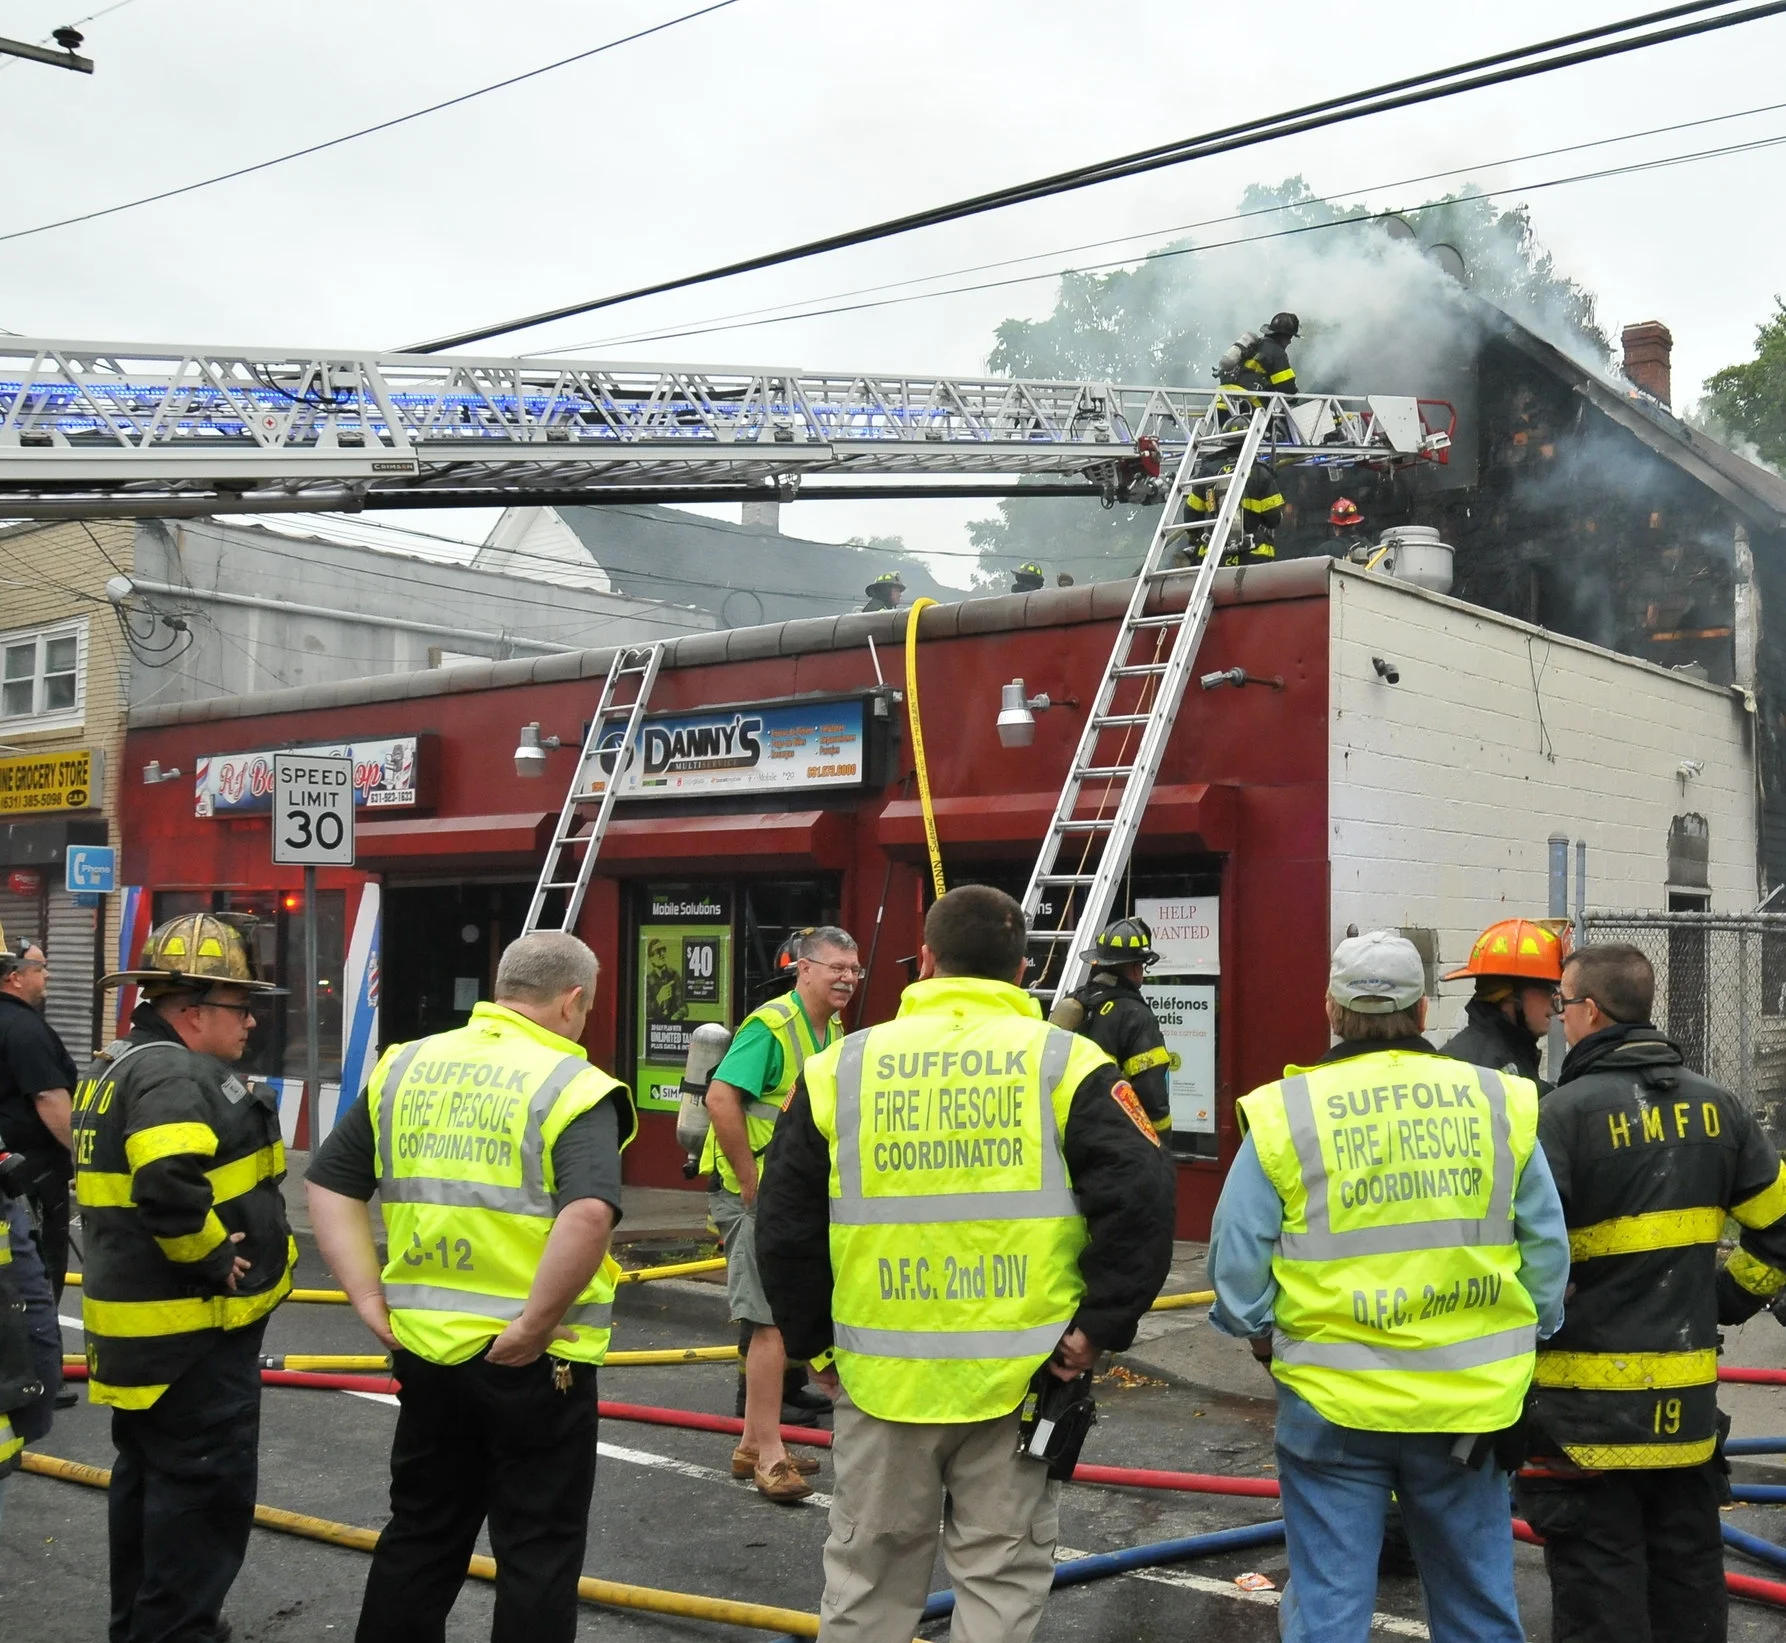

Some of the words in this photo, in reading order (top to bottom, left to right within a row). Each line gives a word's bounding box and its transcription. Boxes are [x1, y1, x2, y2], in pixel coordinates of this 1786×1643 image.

[1225, 555, 1240, 566] 24
[643, 714, 762, 774] DANNY'S
[15, 763, 56, 792] GROCERY
[58, 760, 88, 788] STORE
[218, 762, 248, 797] RJ
[281, 767, 347, 786] SPEED
[289, 790, 339, 807] LIMIT
[284, 810, 344, 850] 30
[82, 864, 111, 874] Phone
[652, 902, 679, 915] Mobile
[680, 902, 721, 915] Solutions
[1159, 905, 1197, 920] HELP
[1151, 925, 1210, 940] WANTED
[687, 945, 713, 977] $40
[1145, 996, 1208, 1011] Teléfonos
[409, 1061, 532, 1093] SUFFOLK
[877, 1050, 1028, 1080] SUFFOLK
[400, 1090, 434, 1127] FIRE
[447, 1091, 519, 1135] RESCUE
[874, 1090, 920, 1132] FIRE
[939, 1086, 1025, 1130] RESCUE
[1327, 1083, 1476, 1119] SUFFOLK
[399, 1132, 512, 1167] COORDINATOR
[874, 1138, 1024, 1172] COORDINATOR
[1332, 1124, 1382, 1171] FIRE
[1399, 1117, 1481, 1161] RESCUE
[1341, 1167, 1482, 1209] COORDINATOR
[403, 1232, 474, 1271] C-12
[878, 1258, 938, 1301] D.F.C.
[945, 1255, 986, 1299] 2nd
[993, 1255, 1028, 1298] DIV
[1353, 1287, 1413, 1330] D.F.C.
[1419, 1280, 1460, 1320] 2nd
[1463, 1272, 1501, 1309] DIV
[1654, 1398, 1682, 1435] 19
